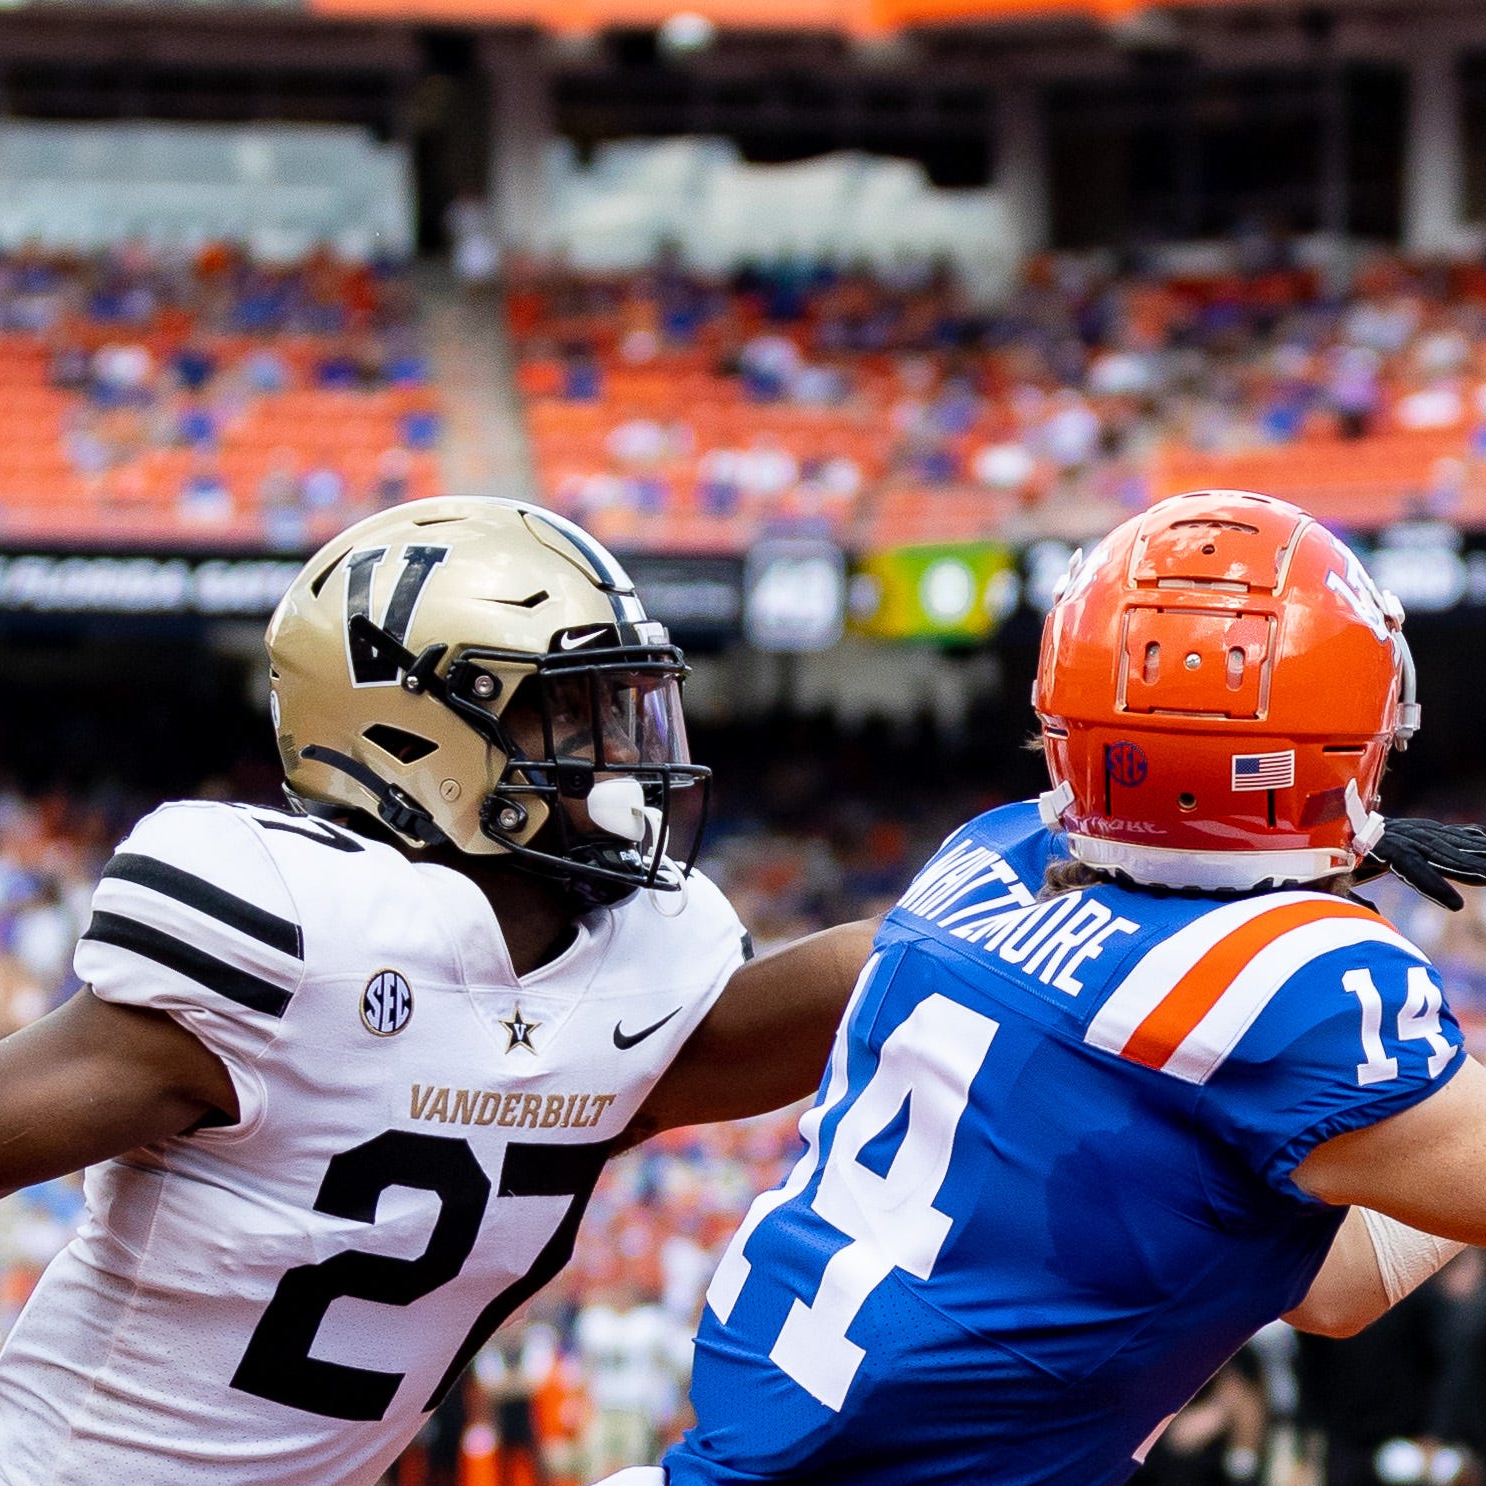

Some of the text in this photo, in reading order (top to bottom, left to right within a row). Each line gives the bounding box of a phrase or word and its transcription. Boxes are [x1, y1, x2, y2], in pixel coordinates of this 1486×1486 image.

[365, 971, 412, 1033] SEC
[1341, 966, 1459, 1087] 14
[409, 1083, 617, 1129] VANDERBILT
[706, 953, 1000, 1413] 14
[229, 1129, 621, 1421] 27
